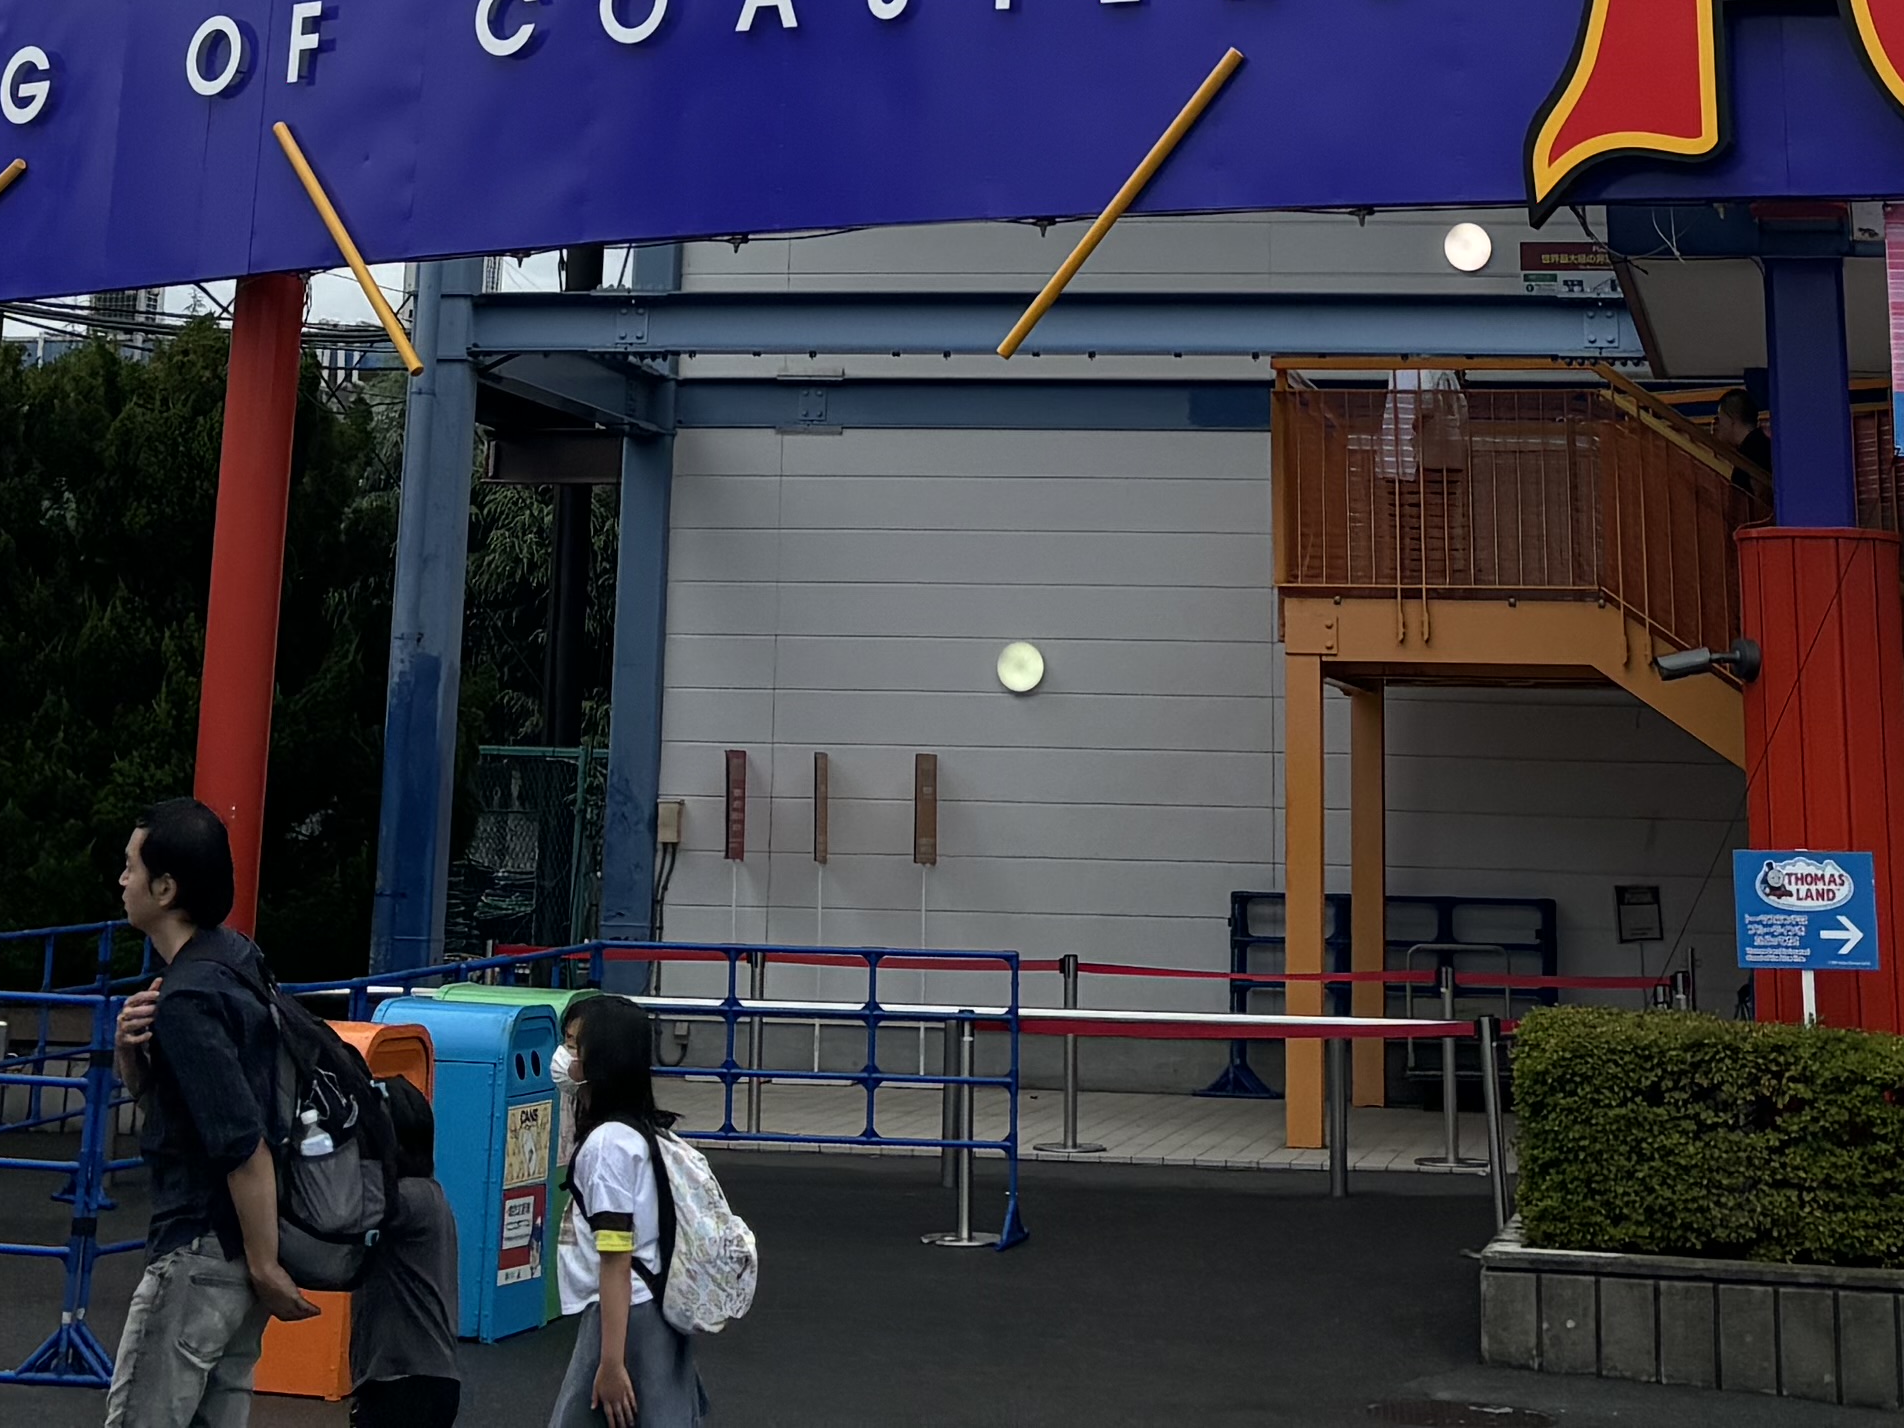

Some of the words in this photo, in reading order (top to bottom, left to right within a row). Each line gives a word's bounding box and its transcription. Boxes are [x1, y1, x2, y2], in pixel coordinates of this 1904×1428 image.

[184, 0, 324, 97] OF
[1784, 872, 1846, 887] THOMAS
[1796, 888, 1837, 902] LAND
